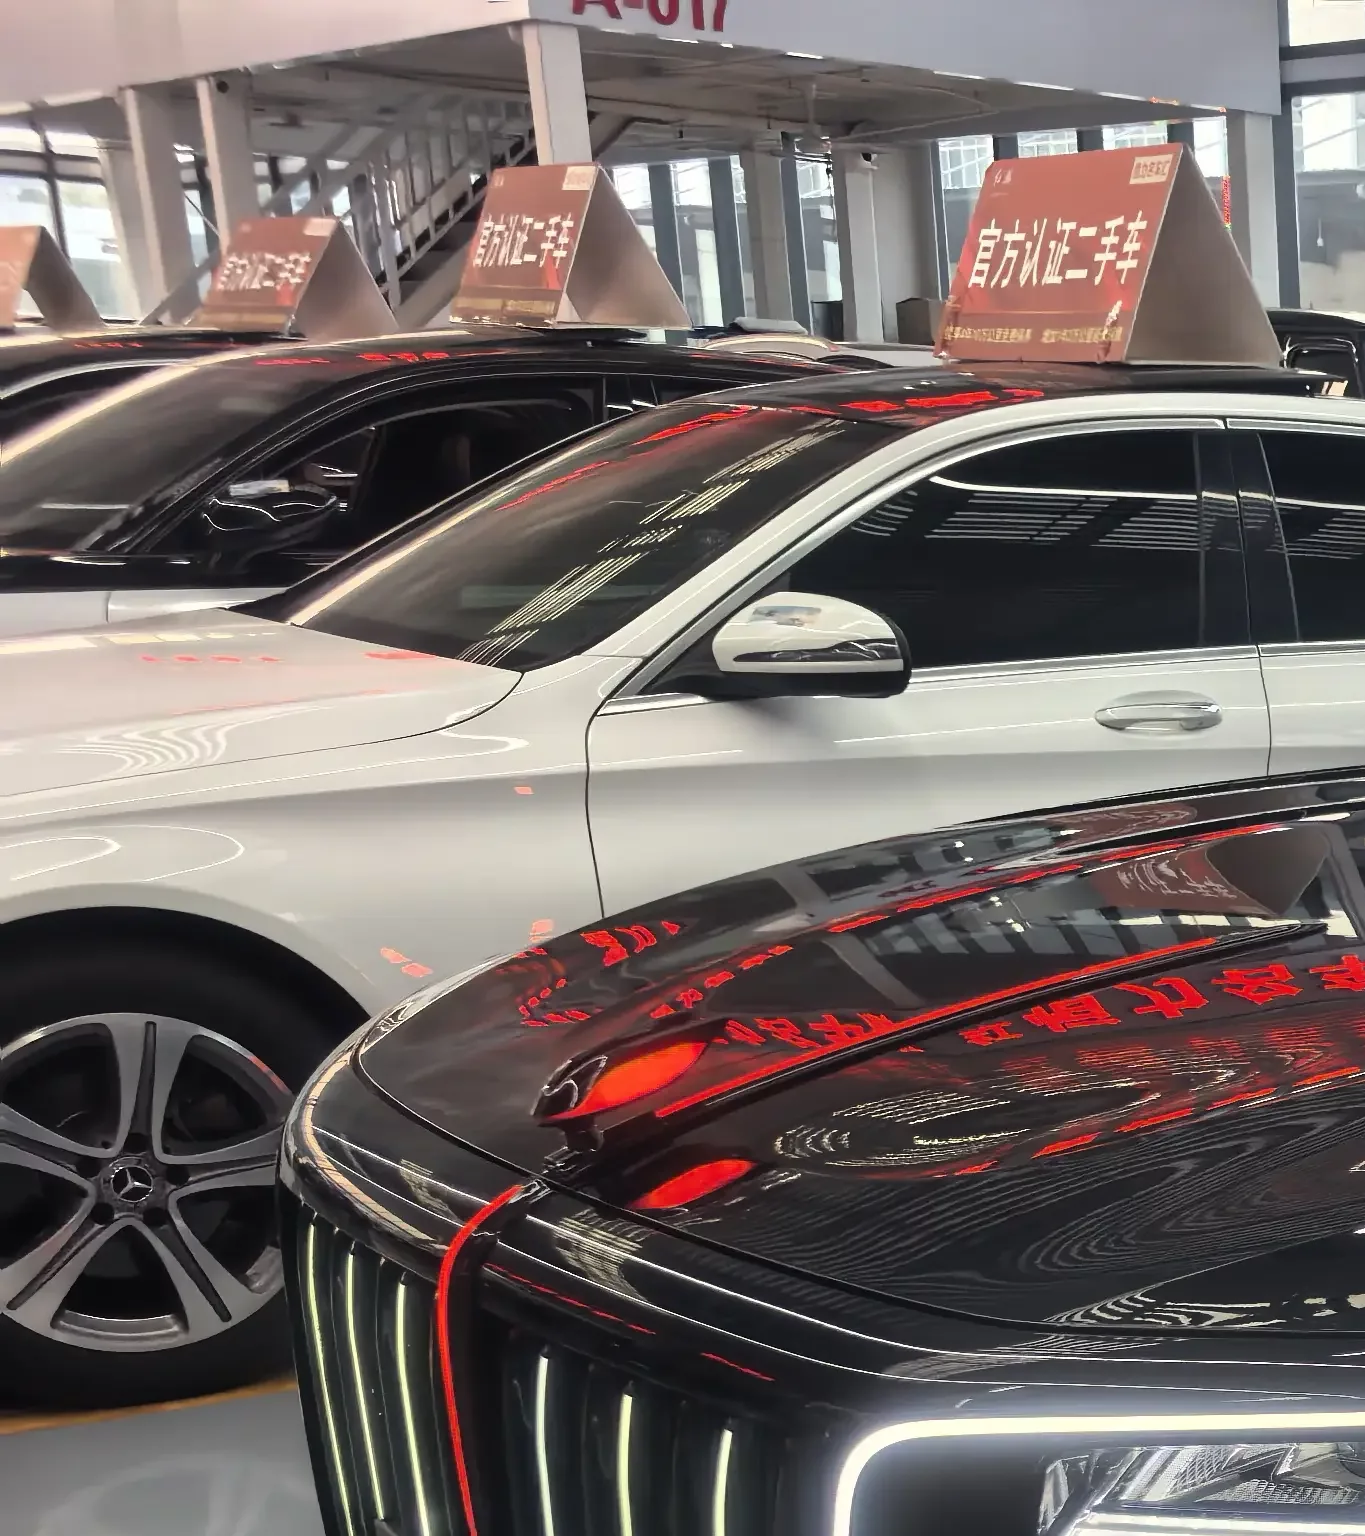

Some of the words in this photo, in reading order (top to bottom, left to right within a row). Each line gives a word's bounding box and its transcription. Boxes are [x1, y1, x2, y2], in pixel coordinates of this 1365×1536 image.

[472, 213, 574, 269] 官方认证二手车
[968, 211, 1148, 288] 官方认证二手车
